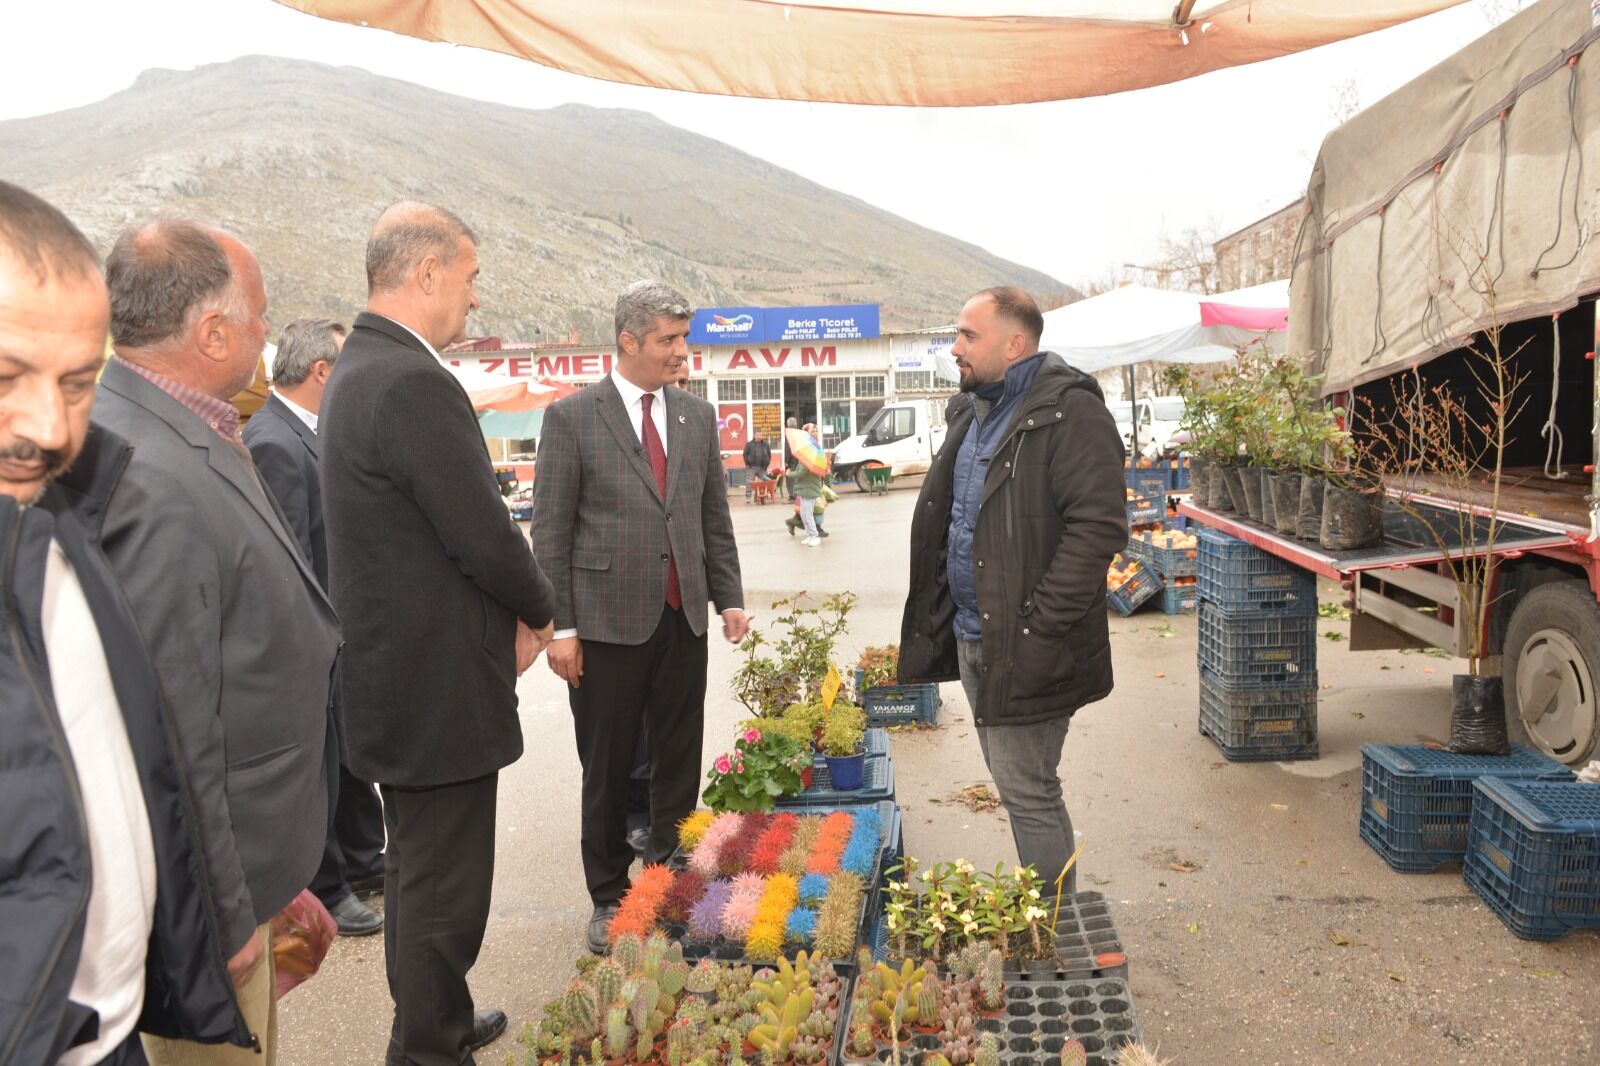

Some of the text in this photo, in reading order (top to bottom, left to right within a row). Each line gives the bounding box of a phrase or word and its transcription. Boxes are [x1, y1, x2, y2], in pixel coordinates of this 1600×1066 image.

[706, 321, 749, 333] Marshall
[788, 317, 855, 328] Berke Ticaret
[726, 346, 837, 370] AVM
